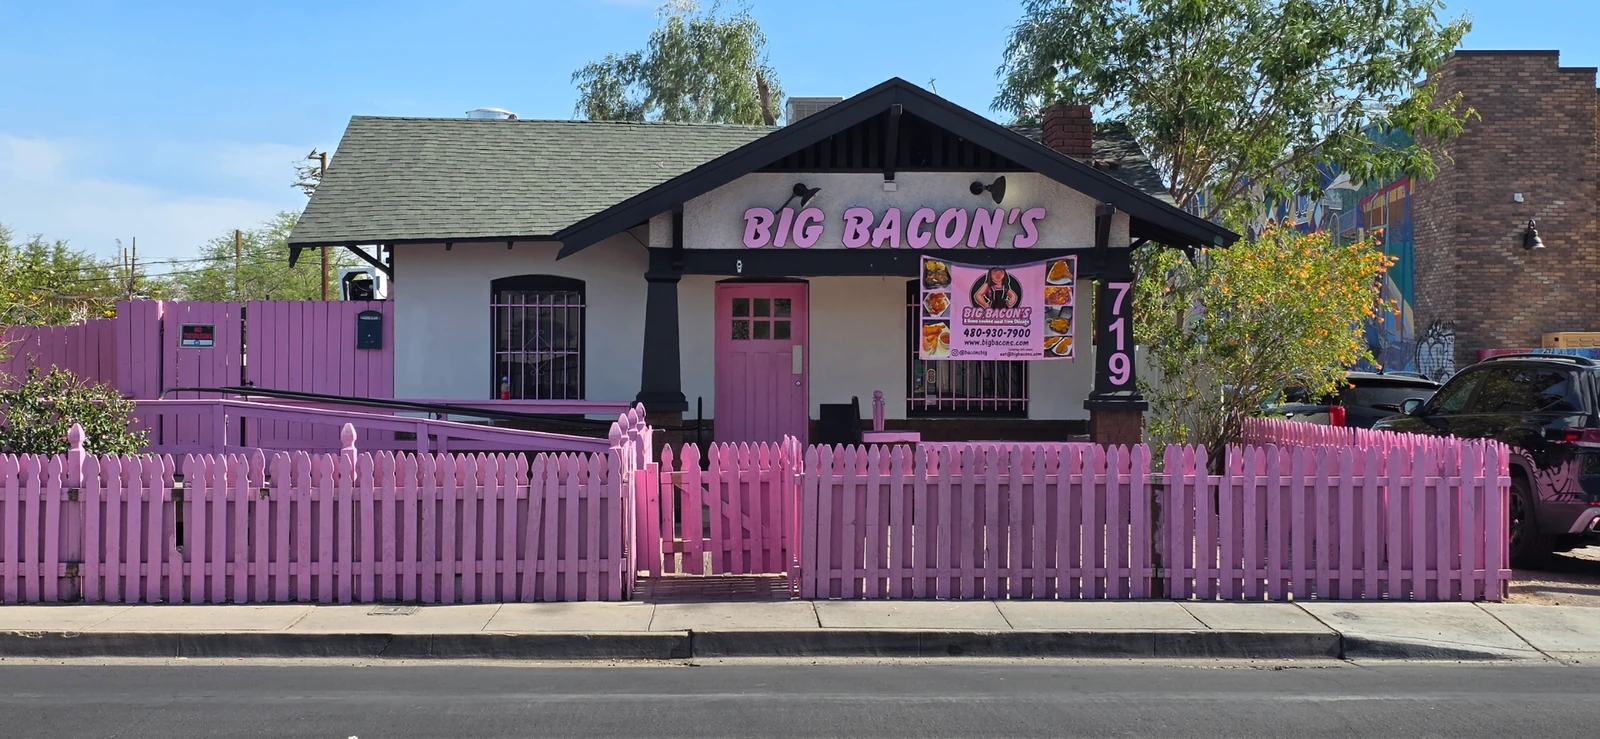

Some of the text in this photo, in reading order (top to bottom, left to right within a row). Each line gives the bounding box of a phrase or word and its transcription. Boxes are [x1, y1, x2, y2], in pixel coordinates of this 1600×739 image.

[742, 207, 1047, 249] BIG BACON'S
[964, 308, 1030, 318] BIG BACON'S
[963, 328, 1031, 338] 480-930-7900
[1108, 282, 1131, 386] 719
[964, 339, 1029, 347] www.bigbacons.com
